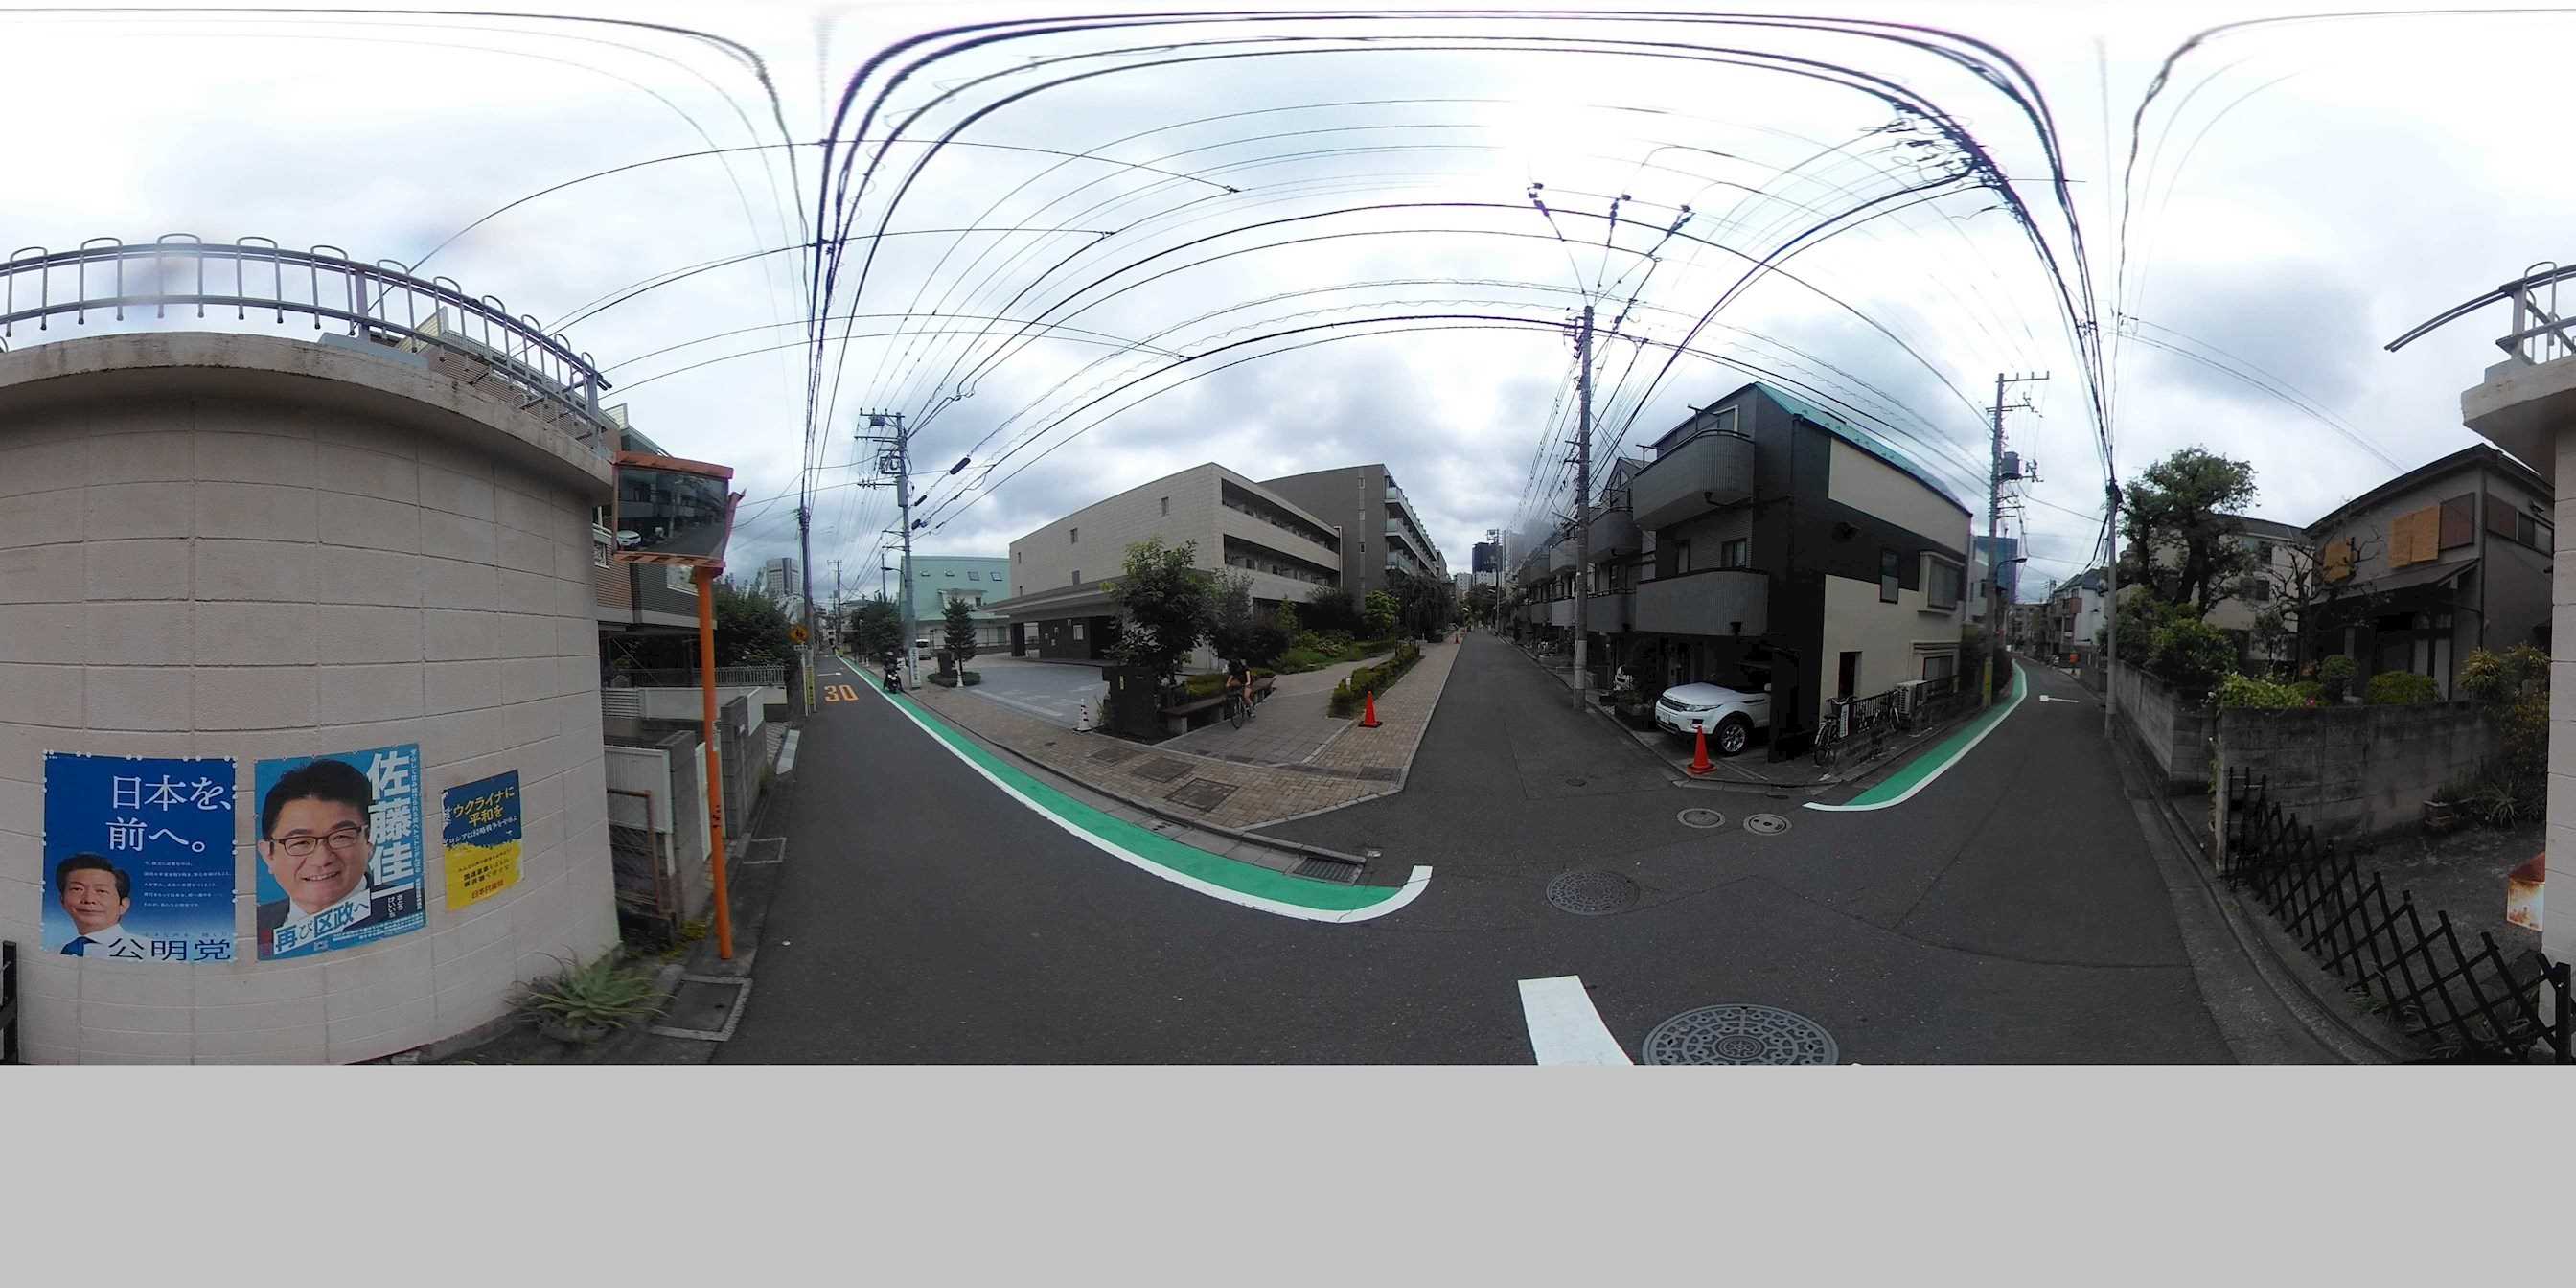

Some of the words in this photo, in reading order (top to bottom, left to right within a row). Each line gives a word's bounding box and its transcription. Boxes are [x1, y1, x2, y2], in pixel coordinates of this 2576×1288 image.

[824, 684, 859, 702] 30
[112, 774, 232, 812] 日本を、
[453, 786, 516, 818] ウクライナに
[366, 750, 415, 900] 佐藤佳一
[469, 804, 504, 827] 平和を
[105, 816, 206, 853] 前へ。
[275, 901, 370, 952] 再び区政へ
[108, 938, 231, 961] 公明党
